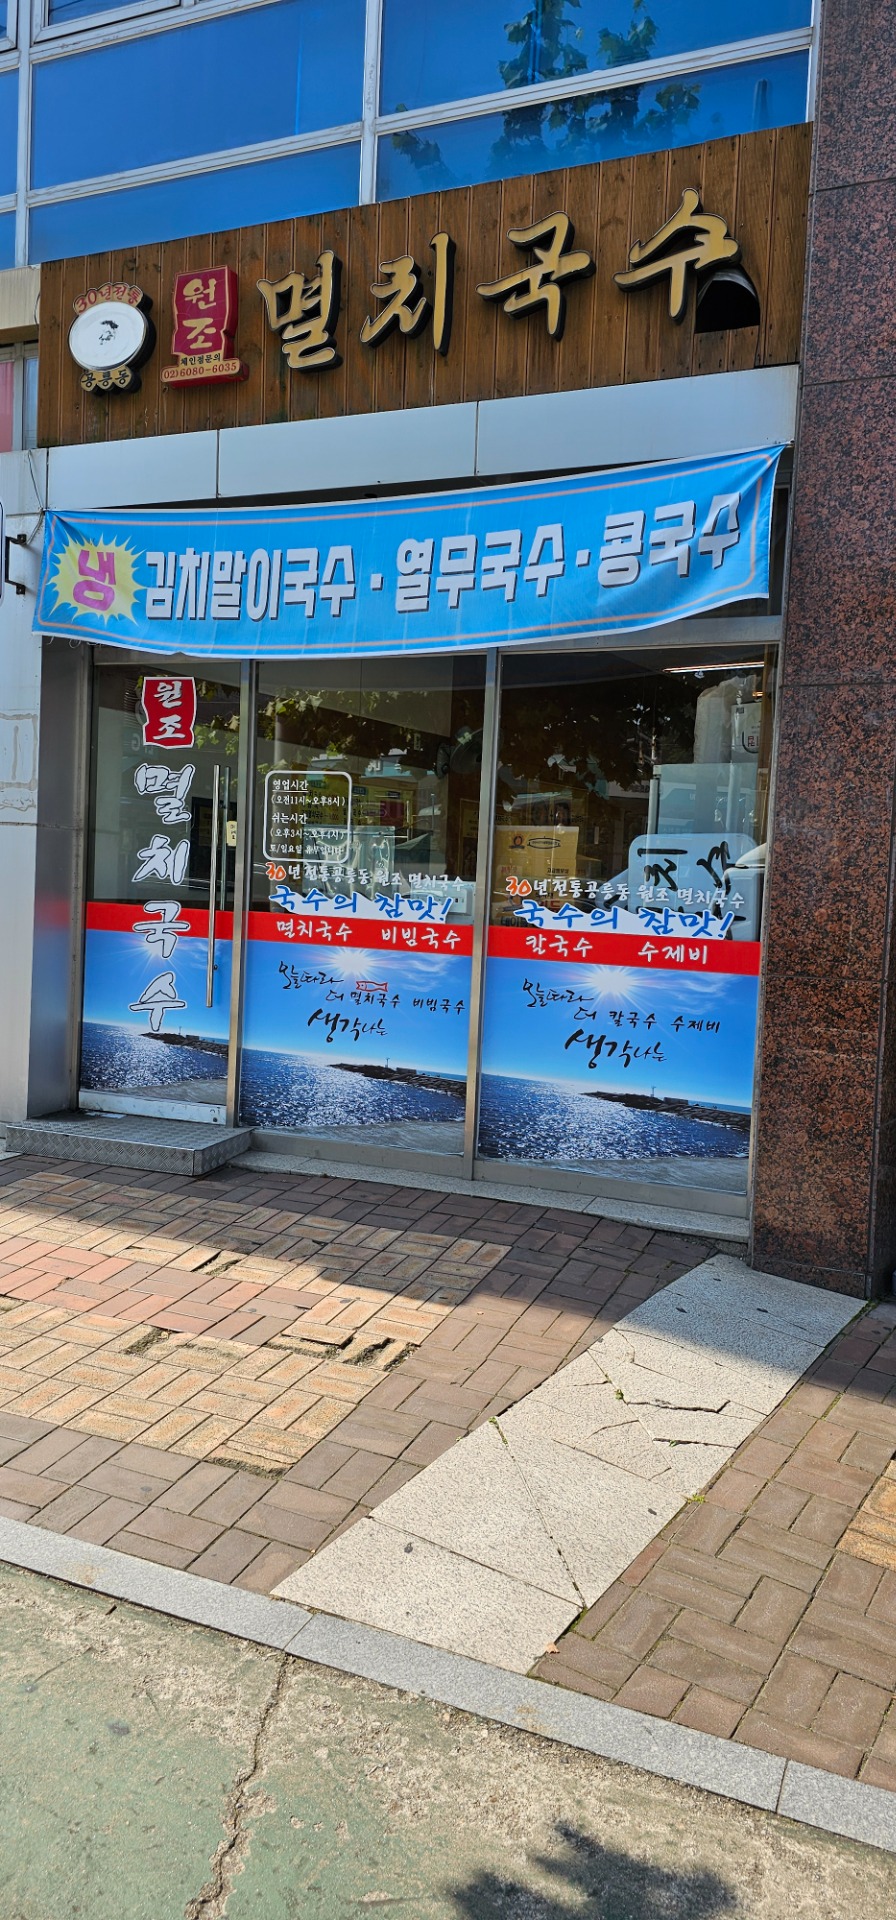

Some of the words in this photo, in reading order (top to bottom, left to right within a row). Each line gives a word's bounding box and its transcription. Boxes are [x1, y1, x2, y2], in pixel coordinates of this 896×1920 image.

[256, 187, 741, 372] 멸치국수
[75, 284, 142, 314] 30년전통
[182, 278, 217, 349] 원조
[81, 369, 131, 389] 공릉동
[163, 362, 237, 379] 02)6080-6035
[145, 544, 357, 622] 김치말이국수
[395, 522, 565, 613] 열무국수
[597, 491, 742, 590] 콩국수
[72, 549, 116, 611] 냉
[153, 681, 186, 740] 원조
[272, 779, 308, 791] 영업시간
[271, 812, 308, 825] 쉬는시간
[375, 868, 402, 887] 원조
[408, 872, 465, 892] 멸치국수
[128, 763, 196, 1034] 멸치국수
[268, 885, 358, 913] 국수의
[374, 892, 453, 922] 참맛!
[636, 885, 671, 903] 원조
[677, 887, 746, 909] 멸치국수
[276, 919, 353, 942] 멸치국수
[381, 925, 462, 950] 비빔국수
[513, 899, 619, 930] 국수의
[638, 906, 735, 938] 참맛!
[525, 933, 594, 958] 칼국수
[637, 941, 709, 965] 수제비
[325, 989, 344, 1002] 더
[350, 991, 401, 1008] 멸치국수
[412, 997, 466, 1016] 비빔국수
[307, 1008, 389, 1043] 생각나는
[573, 1006, 597, 1021] 더
[608, 1010, 657, 1030] 칼국수
[671, 1015, 721, 1033] 수제비
[564, 1028, 668, 1069] 생각나는
